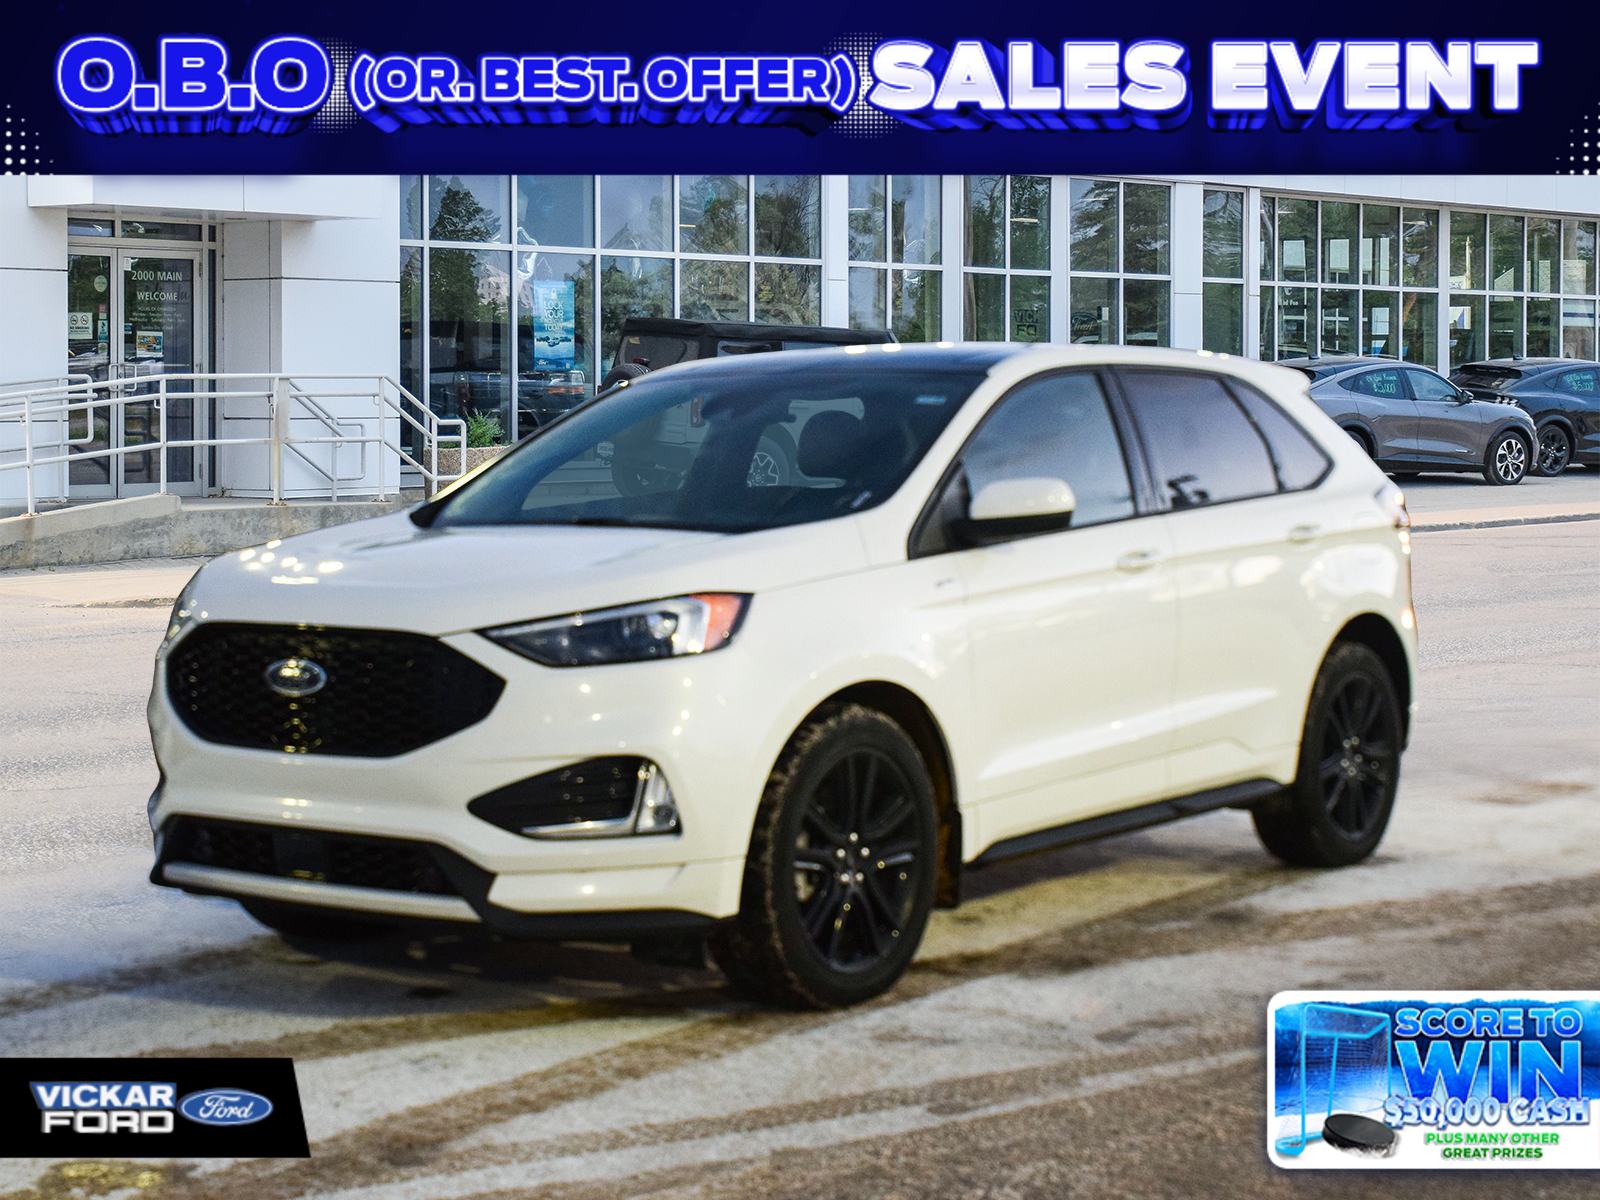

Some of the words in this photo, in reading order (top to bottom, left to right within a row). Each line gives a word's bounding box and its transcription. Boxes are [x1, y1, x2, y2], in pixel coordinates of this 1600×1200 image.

[131, 270, 155, 281] 2000
[157, 271, 183, 282] MAIN
[136, 291, 178, 301] WELCOME
[544, 309, 565, 319] YOUR
